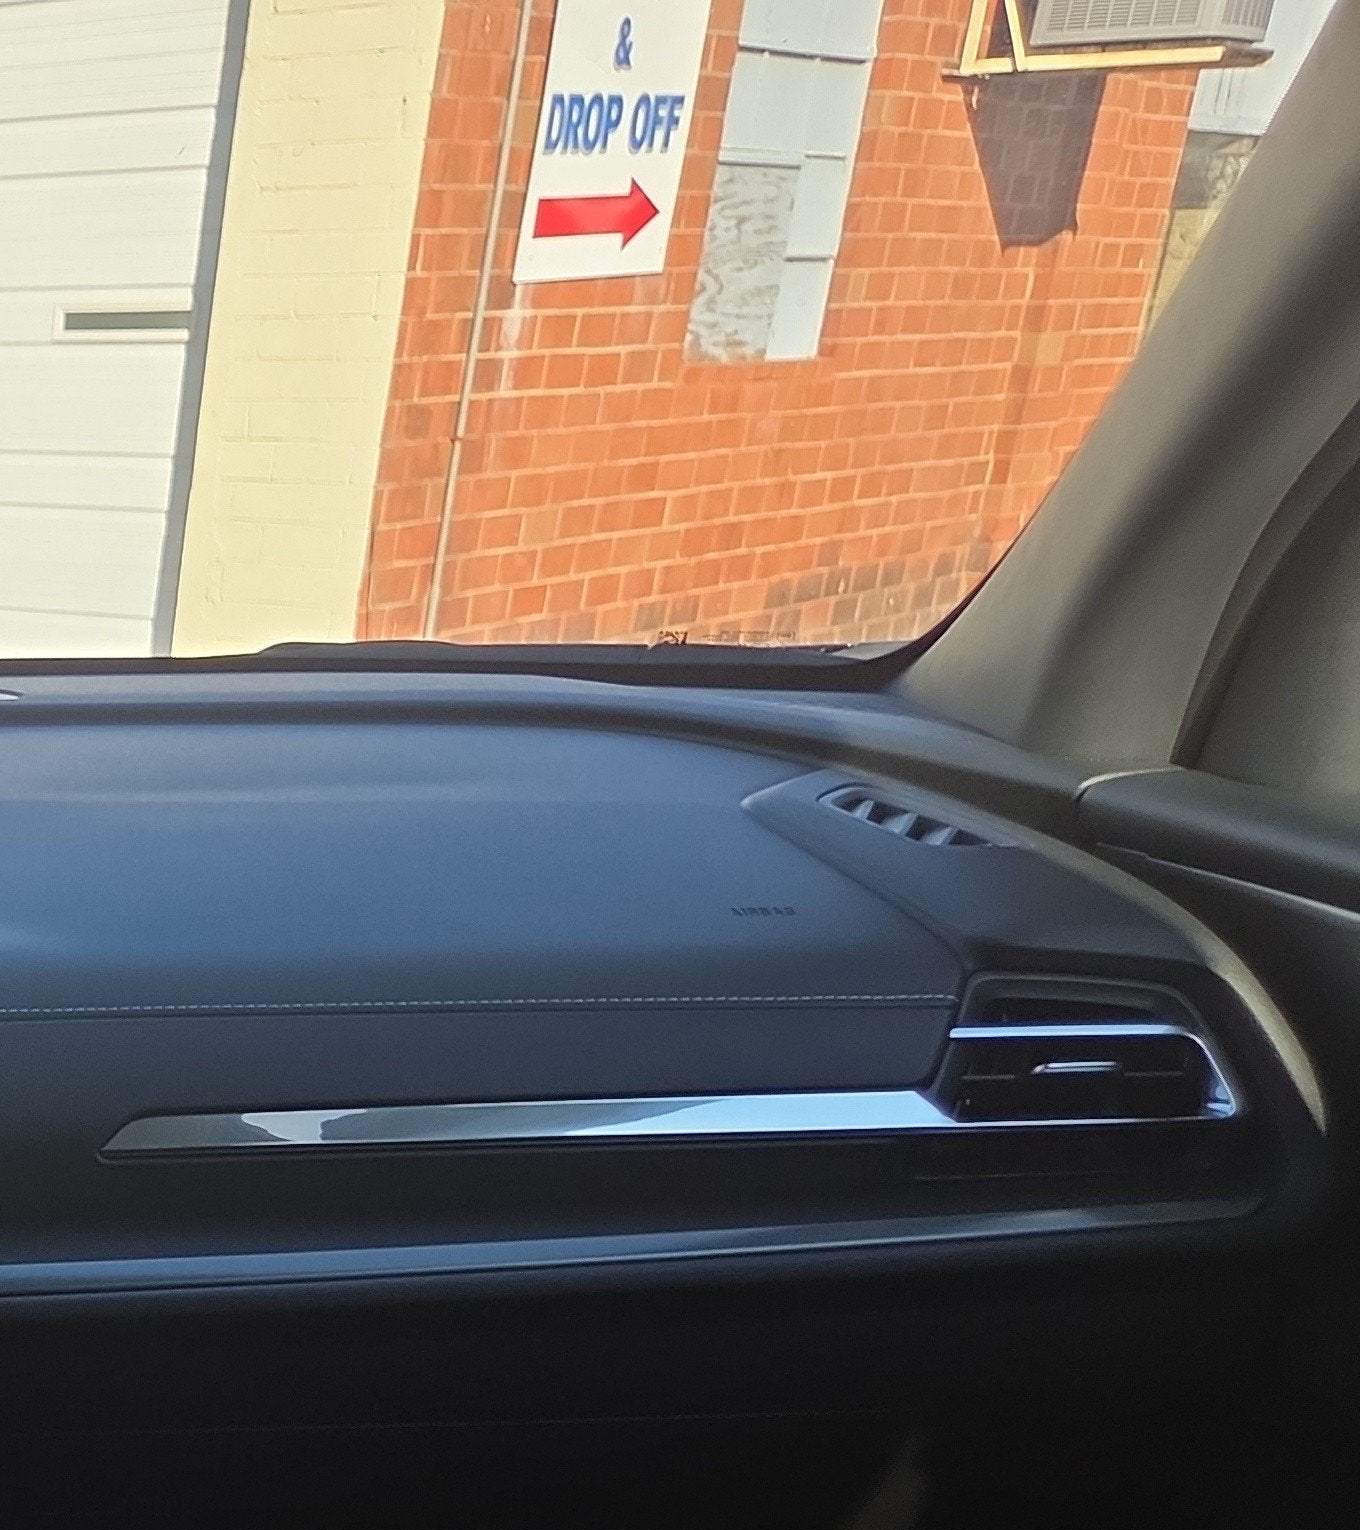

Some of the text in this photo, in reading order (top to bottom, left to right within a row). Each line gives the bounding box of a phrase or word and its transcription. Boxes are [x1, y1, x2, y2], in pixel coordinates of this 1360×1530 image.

[613, 17, 633, 72] &
[542, 93, 685, 156] DROP OFF
